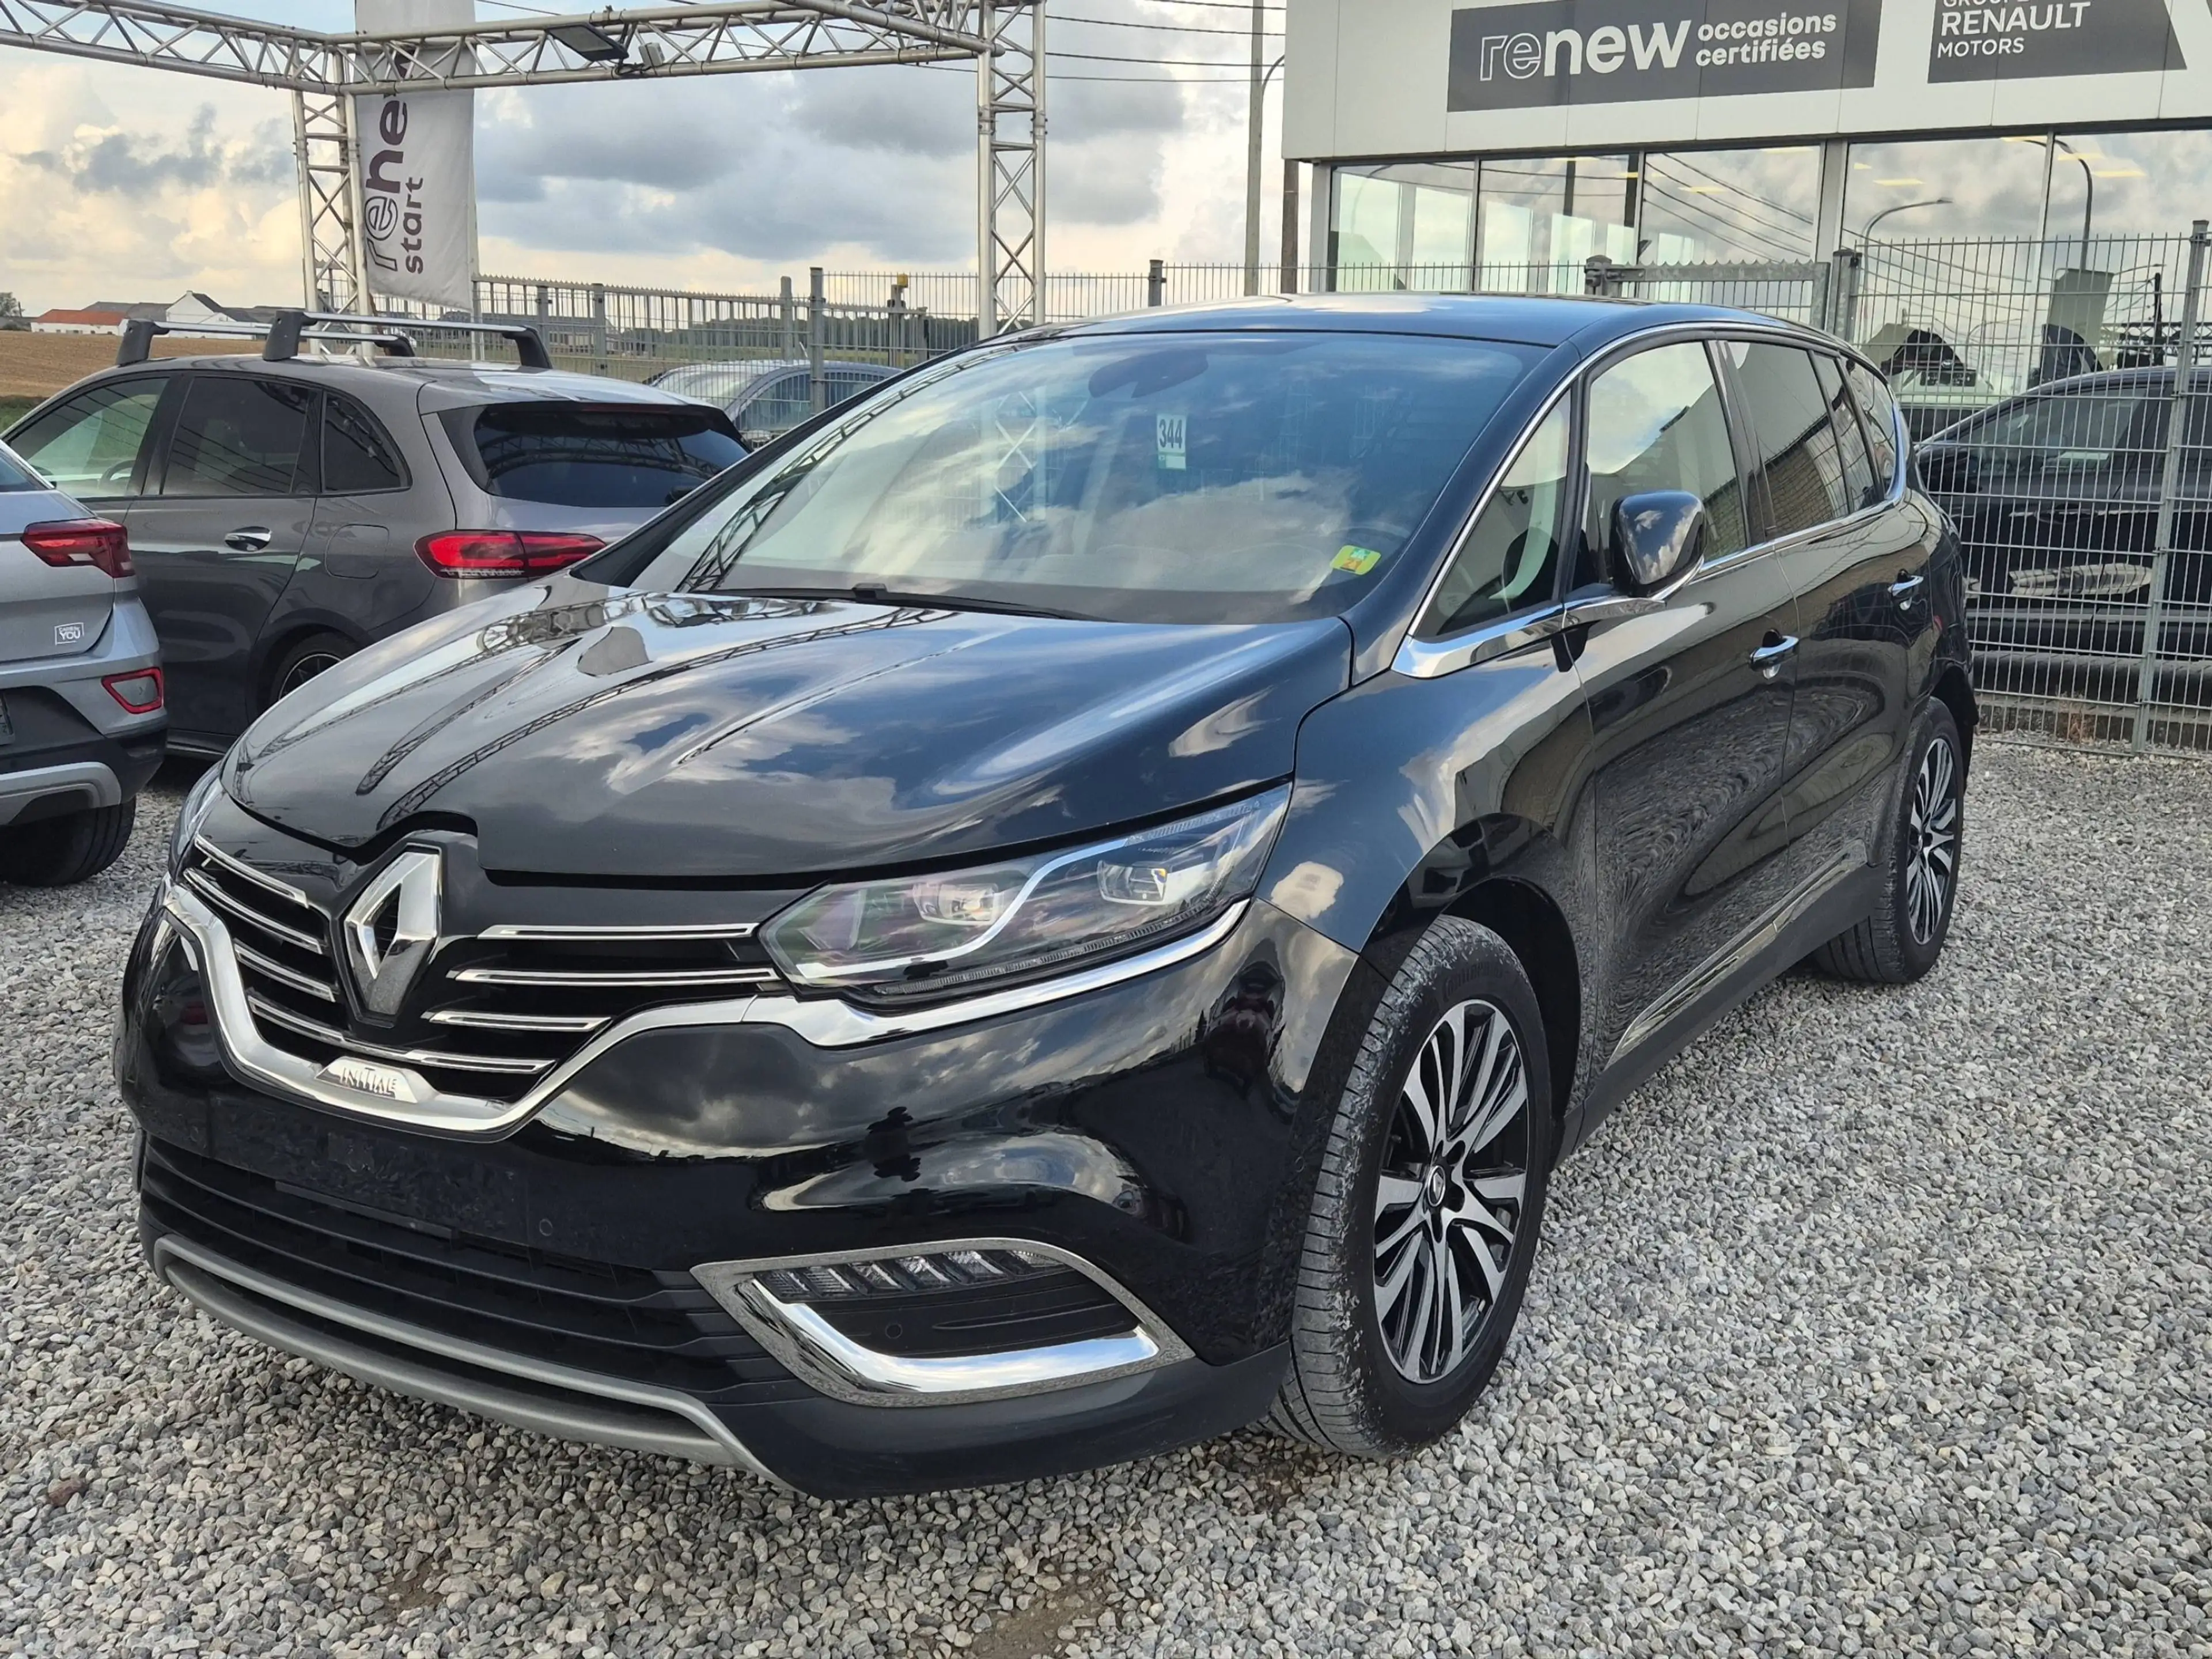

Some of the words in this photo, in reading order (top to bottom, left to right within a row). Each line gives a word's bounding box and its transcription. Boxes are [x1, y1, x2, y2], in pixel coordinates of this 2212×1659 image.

[1941, 2, 2091, 36] RENAULT
[1480, 20, 1692, 81] renew
[1698, 12, 1836, 41] occasions
[1695, 37, 1825, 66] certifiées
[1937, 37, 2024, 58] MOTORS
[401, 177, 423, 274] start
[1159, 418, 1183, 449] 344
[59, 630, 81, 640] YOU
